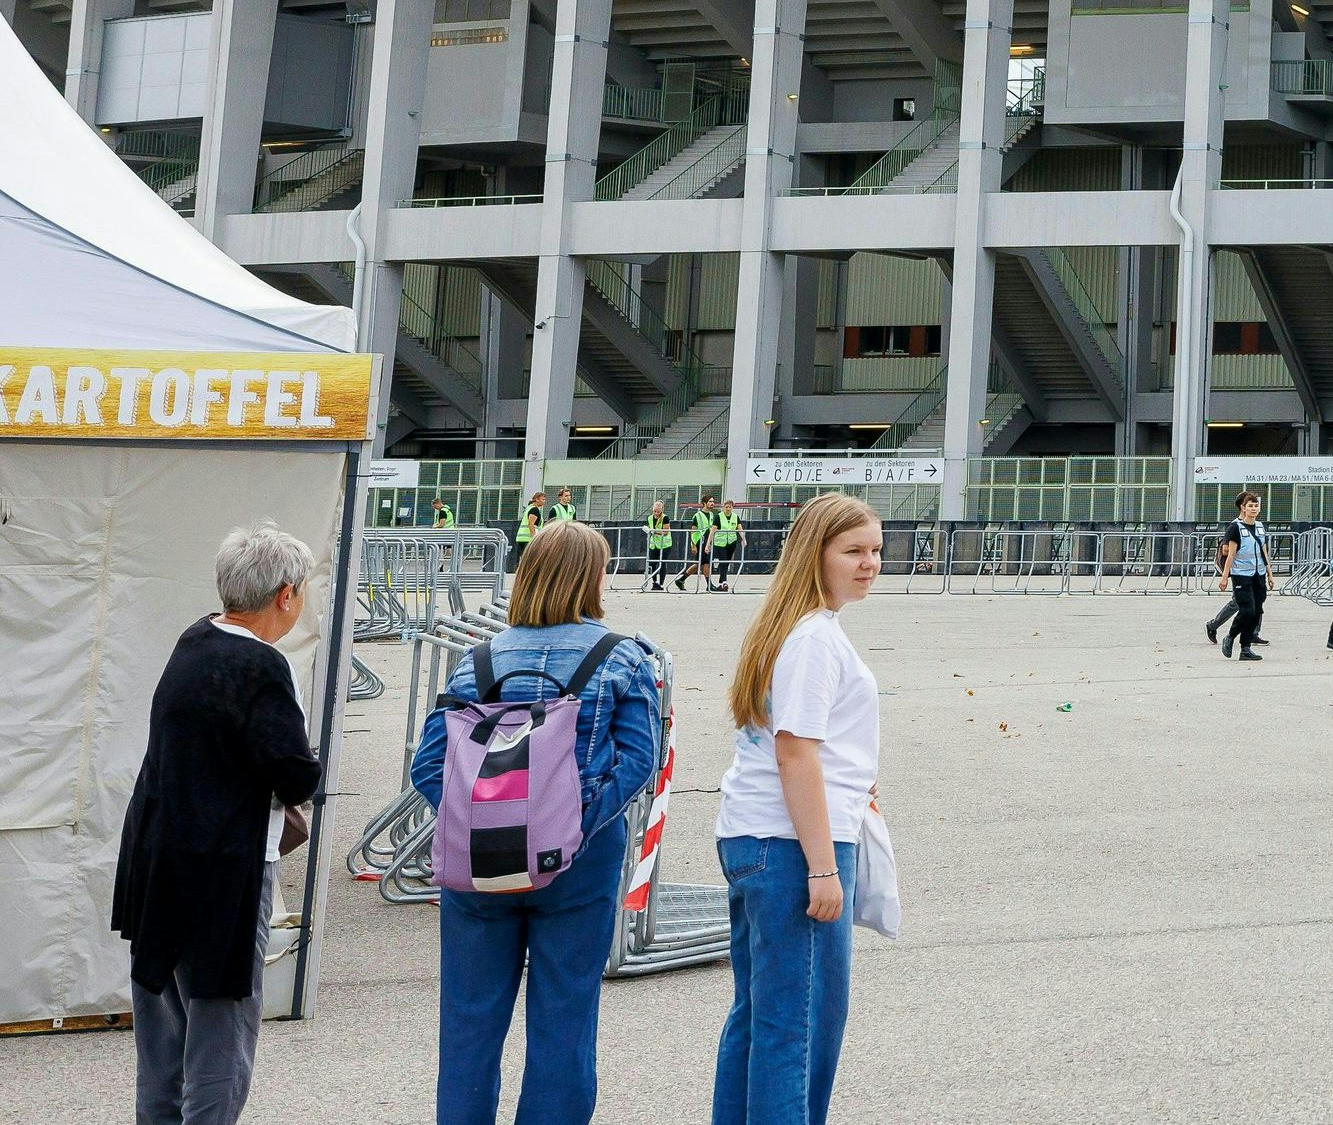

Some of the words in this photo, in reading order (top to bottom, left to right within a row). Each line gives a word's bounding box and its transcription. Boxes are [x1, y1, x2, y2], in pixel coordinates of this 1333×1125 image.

[887, 459, 916, 467] Sektoren
[774, 468, 782, 482] C
[794, 468, 803, 482] D
[815, 468, 823, 482] E
[865, 468, 873, 482] B
[885, 468, 894, 482] A
[908, 468, 915, 482] F
